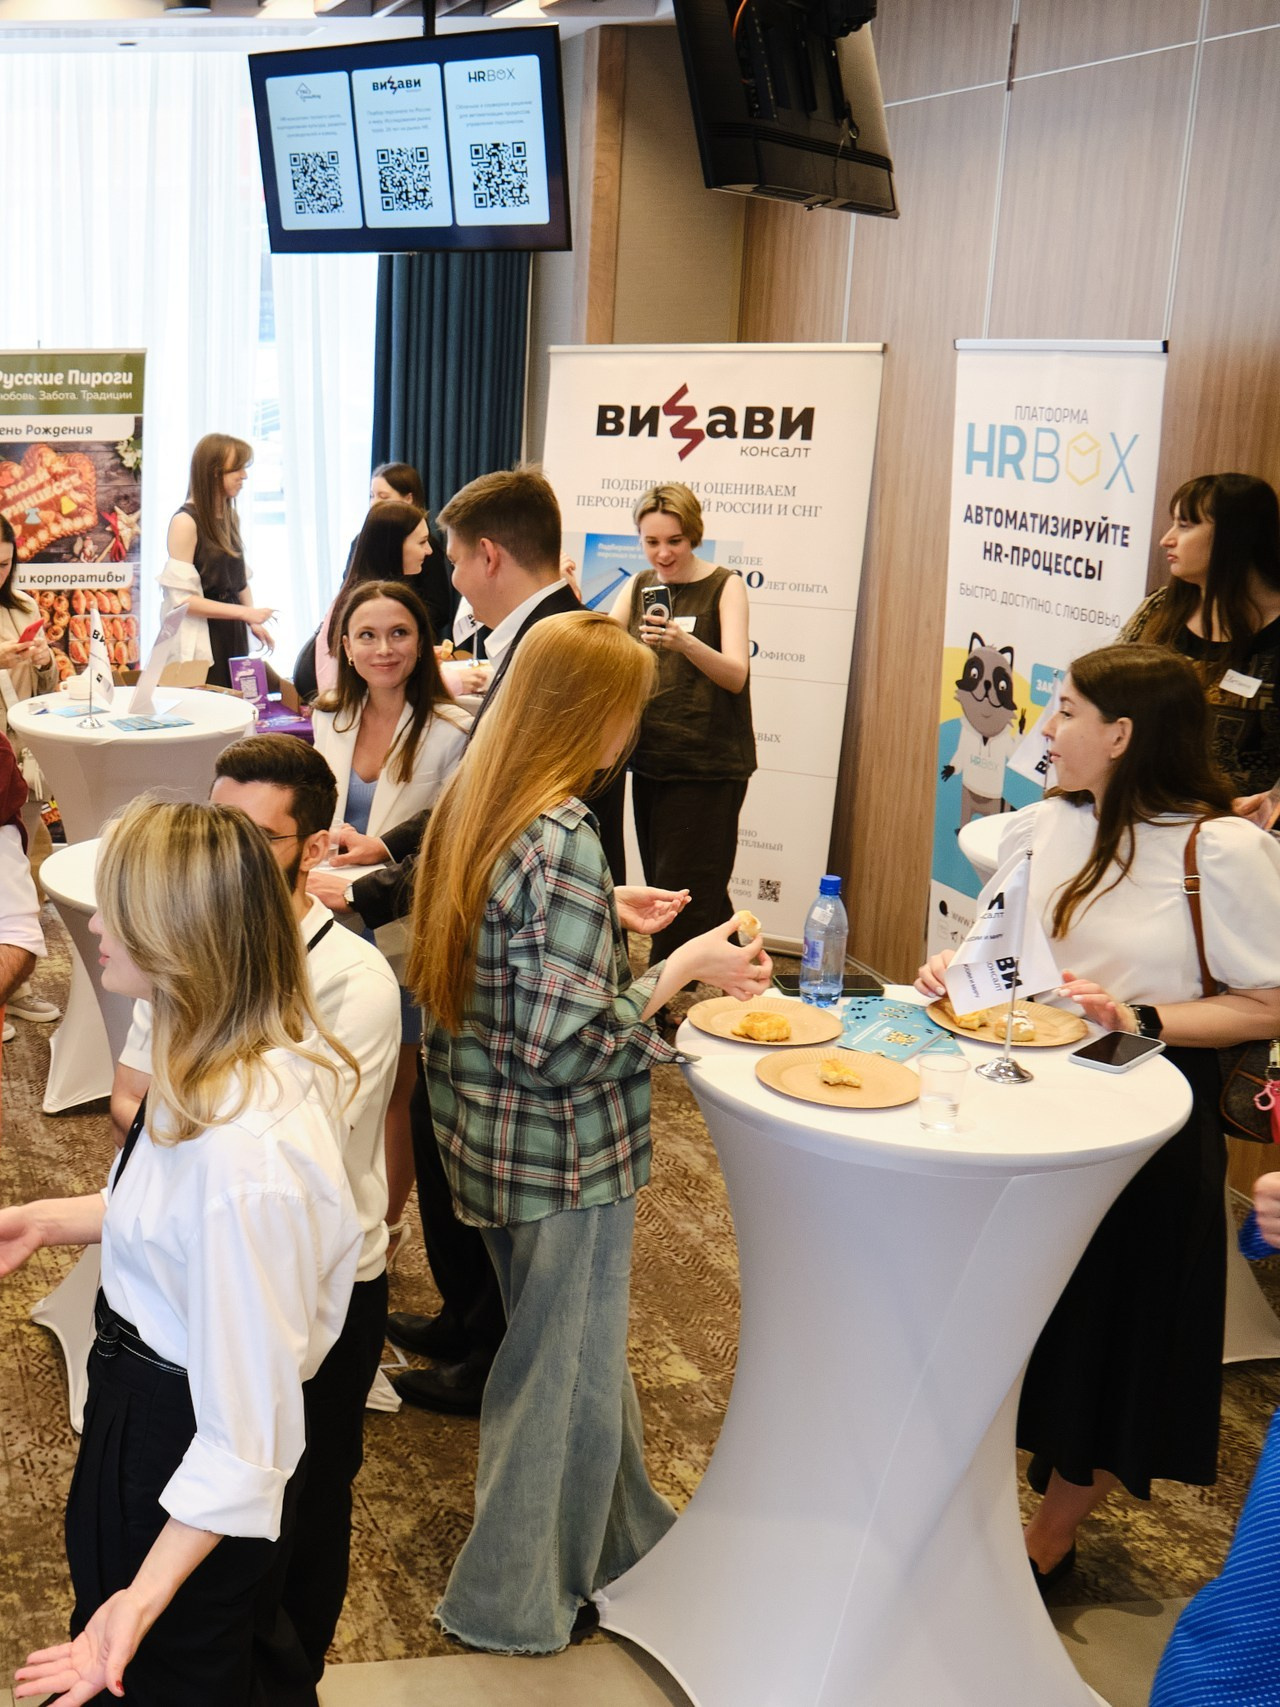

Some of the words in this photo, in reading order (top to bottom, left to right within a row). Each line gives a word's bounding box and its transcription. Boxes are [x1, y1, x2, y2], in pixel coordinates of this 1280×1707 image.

[67, 369, 132, 388] Пироги
[39, 390, 78, 400] Забота.
[80, 390, 132, 402] Традиции
[596, 382, 816, 462] визави
[1014, 405, 1089, 424] ПЛАТФОРМА
[25, 425, 93, 437] Рождения
[740, 446, 812, 458] консалт
[965, 422, 1140, 493] HRBOX
[601, 478, 685, 492] ПОДБИР
[690, 482, 700, 493] И
[704, 482, 797, 497] ОЦЕНИВАЕМ
[715, 501, 773, 515] РОССИИ
[777, 503, 788, 516] И
[792, 504, 823, 517] СНГ
[963, 503, 1131, 548] АВТОМАТИЗИРУЙТЕ
[728, 555, 763, 566] БОЛЕЕ
[983, 541, 1103, 581] HR-ПРОЦЕССЫ
[18, 575, 26, 583] и
[764, 581, 787, 591] ЛЕТ
[788, 582, 828, 594] ОПЫТА
[1055, 602, 1062, 616] С
[760, 650, 806, 663] ОФИСОВ
